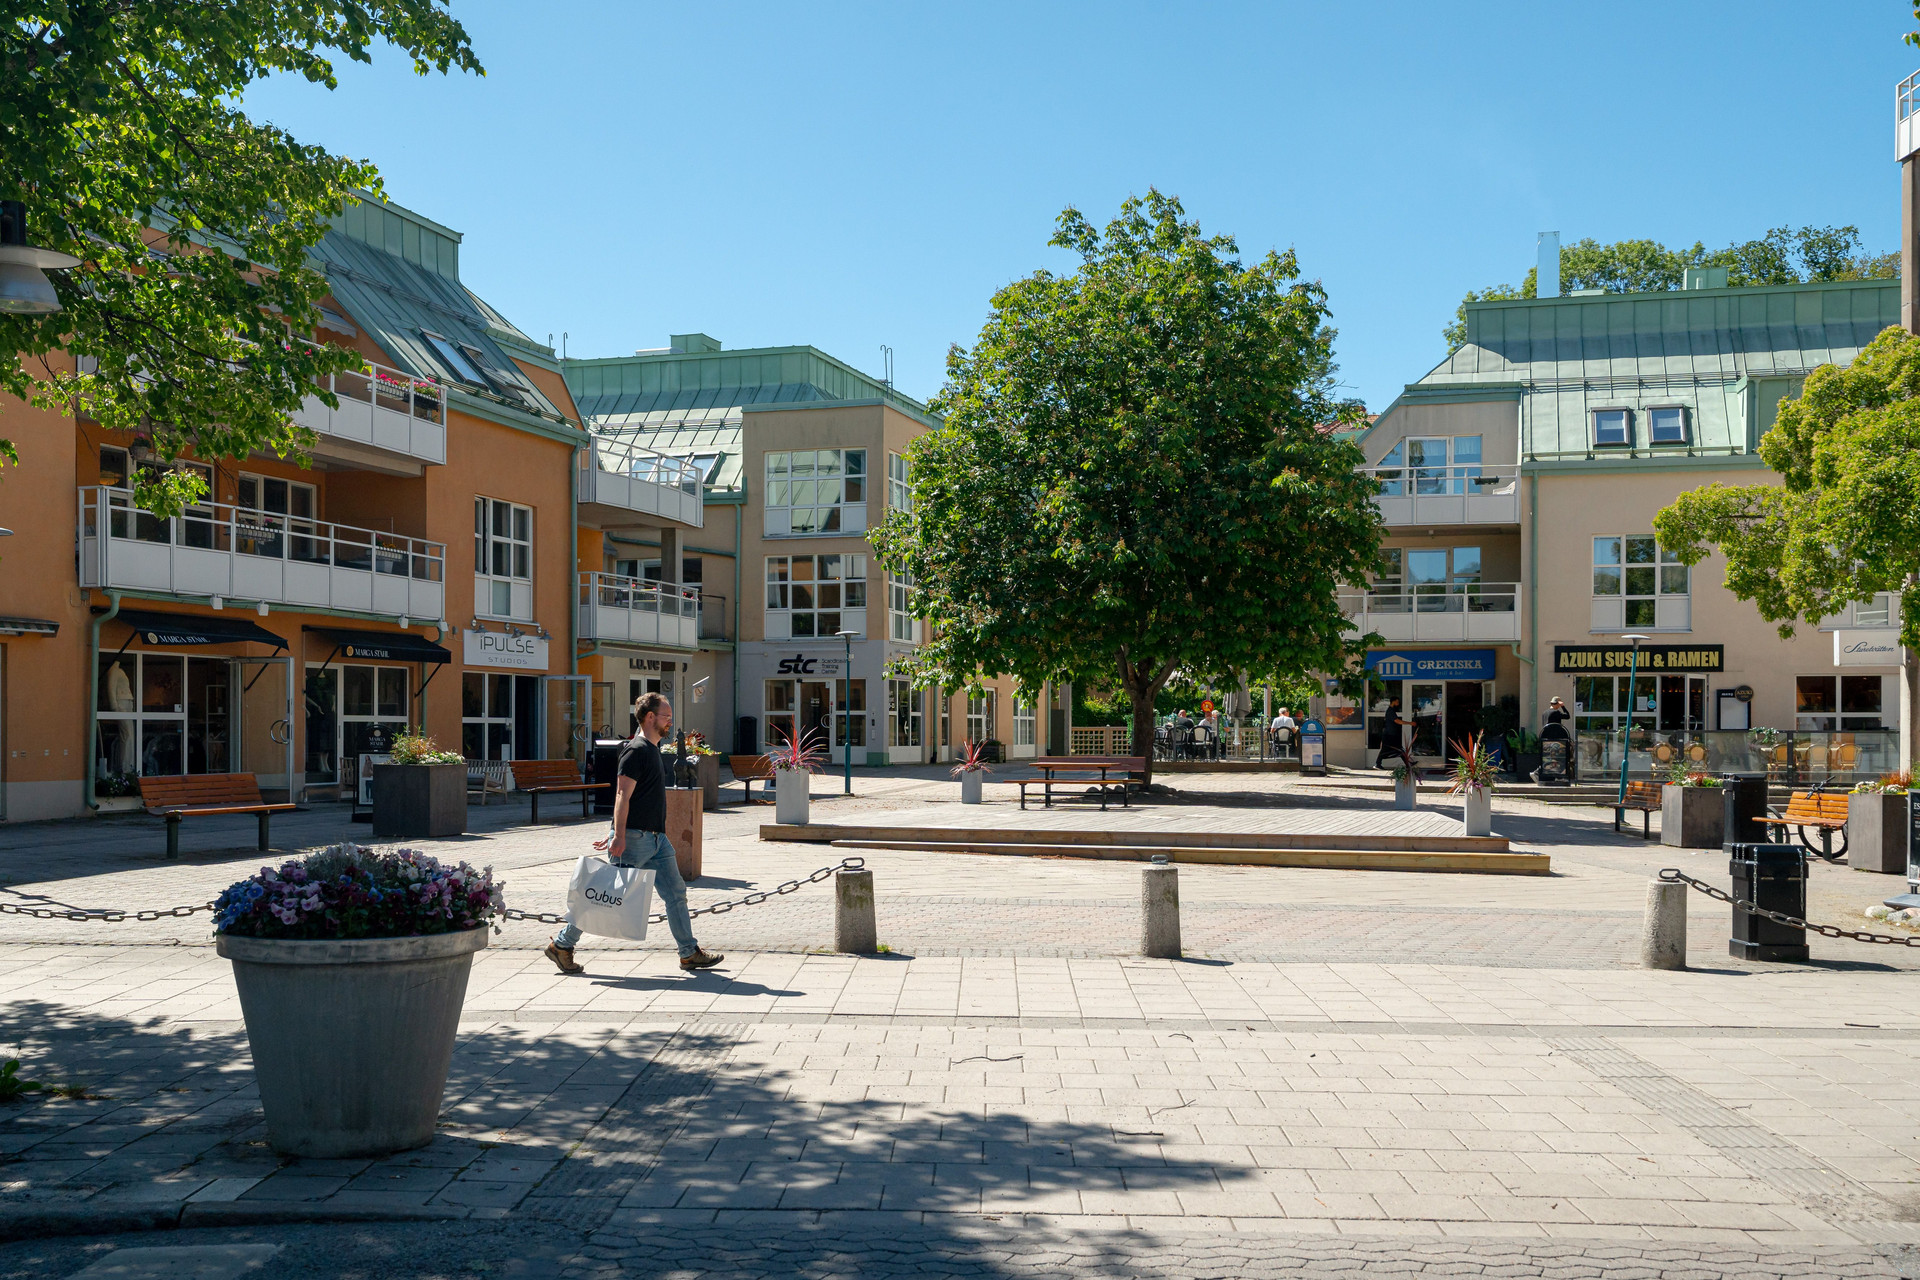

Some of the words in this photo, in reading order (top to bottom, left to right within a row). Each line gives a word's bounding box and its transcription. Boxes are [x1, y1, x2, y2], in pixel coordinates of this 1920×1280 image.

[480, 635, 534, 654] iPULSE
[488, 656, 527, 665] STUDIOS
[777, 654, 818, 674] stc
[1417, 660, 1483, 669] GREKISKA
[1559, 652, 1602, 668] AZUKI
[1605, 651, 1650, 667] SUSHI
[1653, 653, 1665, 667] &
[1667, 651, 1719, 667] RAMEN
[585, 887, 623, 906] Cubus
